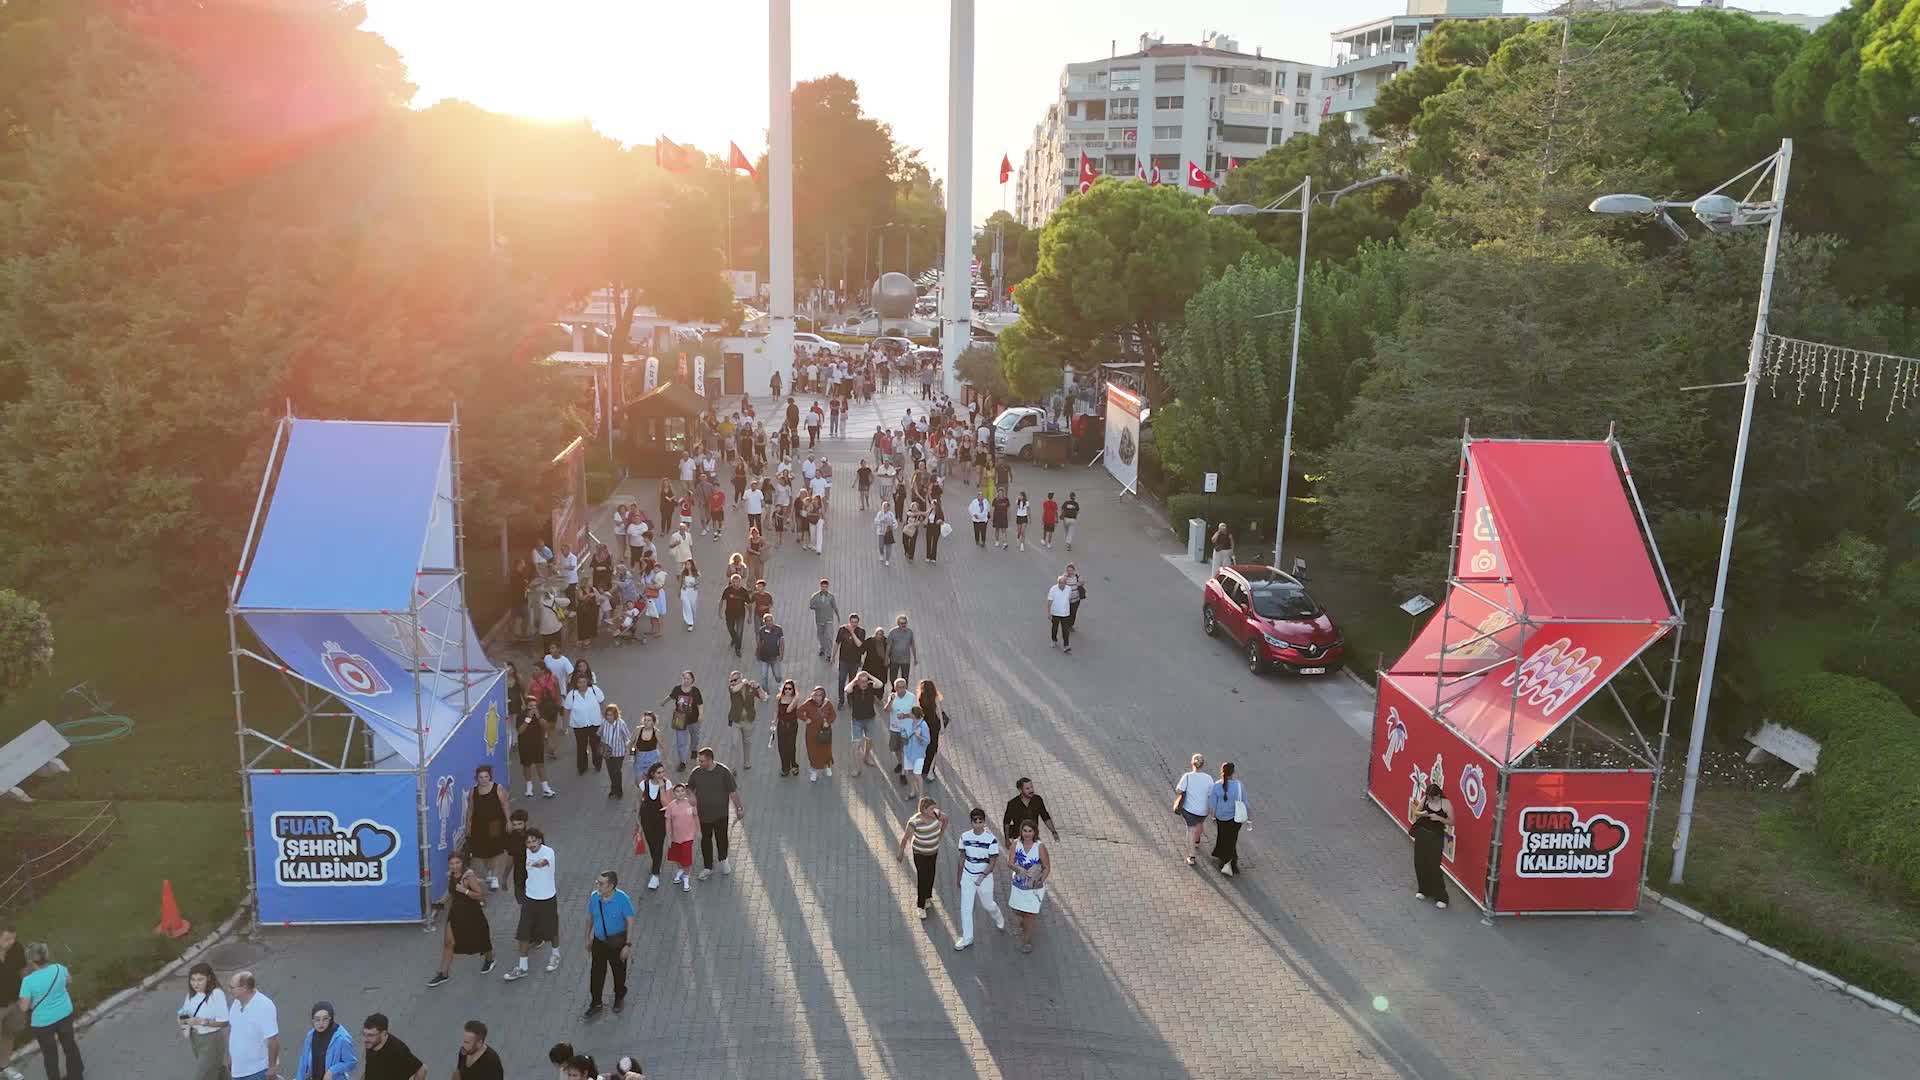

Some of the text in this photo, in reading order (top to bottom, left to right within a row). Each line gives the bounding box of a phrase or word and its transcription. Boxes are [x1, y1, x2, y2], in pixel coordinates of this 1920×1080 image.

[279, 817, 332, 836] FUAR
[1526, 813, 1572, 830] FUAR
[286, 834, 358, 860] ŞEHRİN
[1529, 828, 1592, 853] ŞEHRİN
[282, 857, 379, 880] KALBİNDE
[1523, 850, 1607, 871] KALBİNDE
